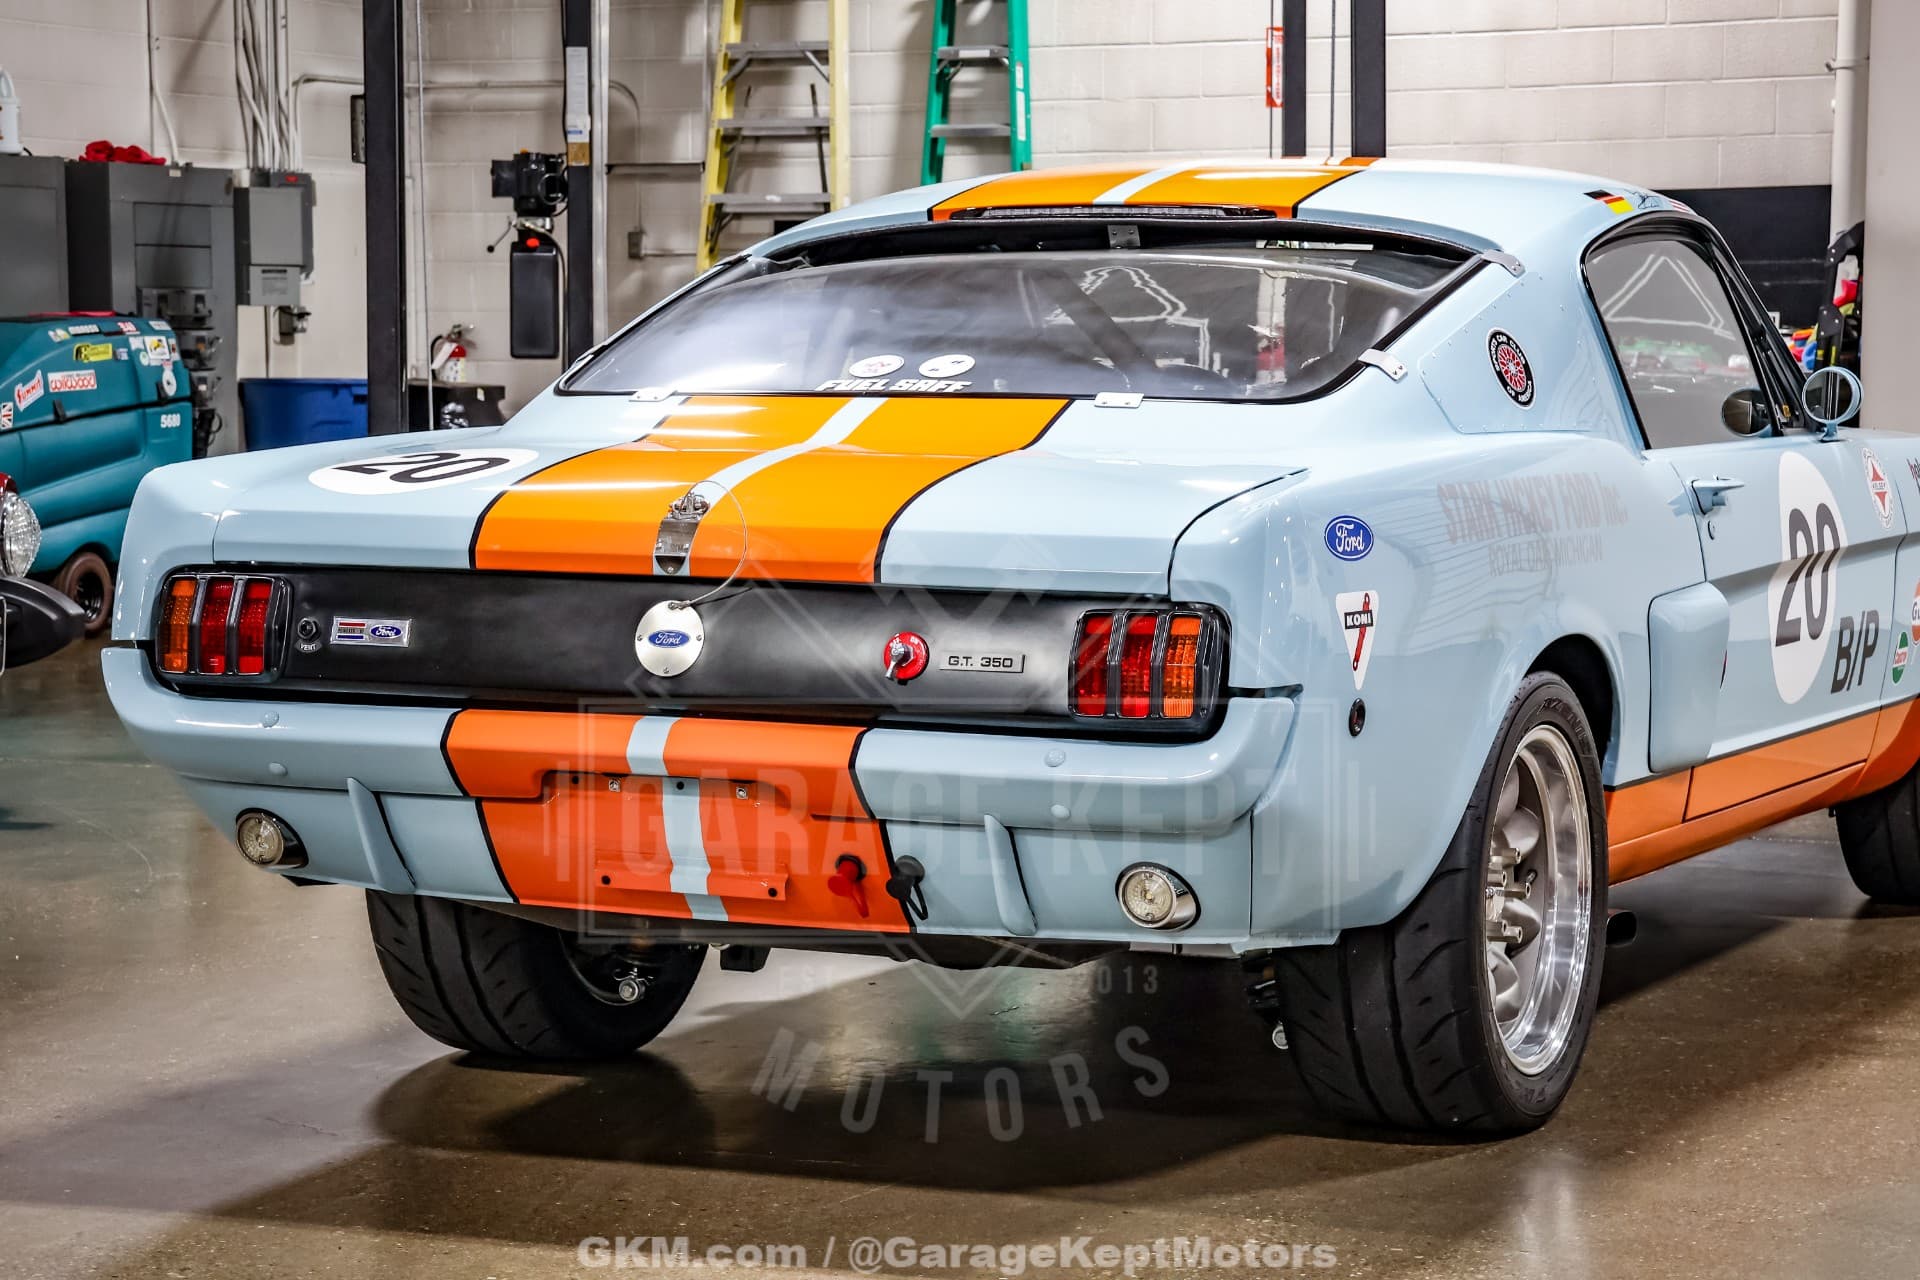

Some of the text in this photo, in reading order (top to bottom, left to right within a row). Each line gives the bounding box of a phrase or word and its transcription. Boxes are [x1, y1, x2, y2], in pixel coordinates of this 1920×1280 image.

[814, 379, 890, 391] FUEL
[332, 452, 510, 484] 20
[1556, 471, 1602, 530] FORD
[1335, 522, 1366, 553] Ford
[1775, 502, 1841, 647] 20
[1346, 612, 1372, 627] KONI
[948, 656, 1013, 668] G.T. 350
[1830, 609, 1880, 695] B/P
